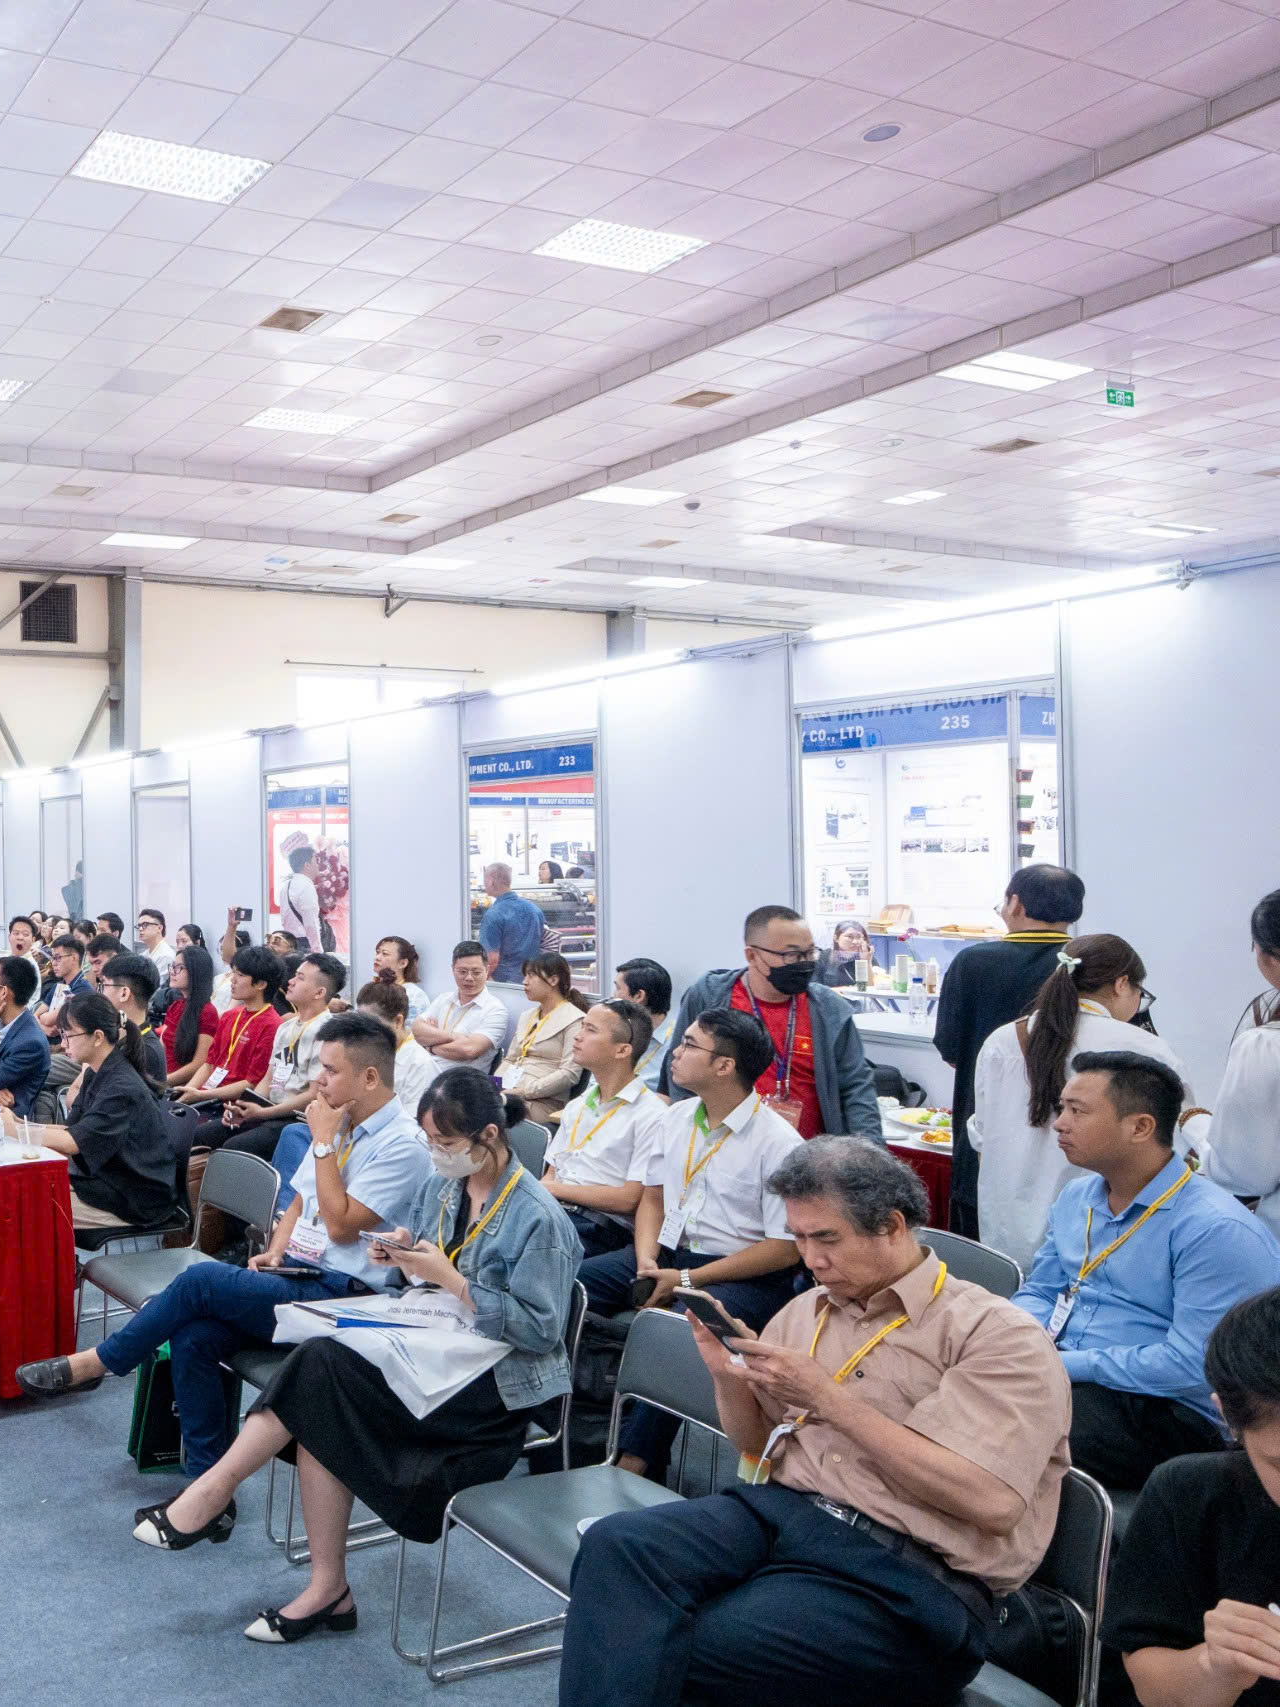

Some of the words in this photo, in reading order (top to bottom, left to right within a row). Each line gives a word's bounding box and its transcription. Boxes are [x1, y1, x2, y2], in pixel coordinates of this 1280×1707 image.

[941, 714, 970, 730] 235
[810, 729, 835, 743] CO.,
[840, 725, 865, 740] LTD
[470, 763, 497, 775] IPMENT
[516, 760, 534, 771] LTD.
[559, 755, 576, 767] 233
[404, 1306, 433, 1316] Jeremiah
[433, 1309, 469, 1329] Machinery
